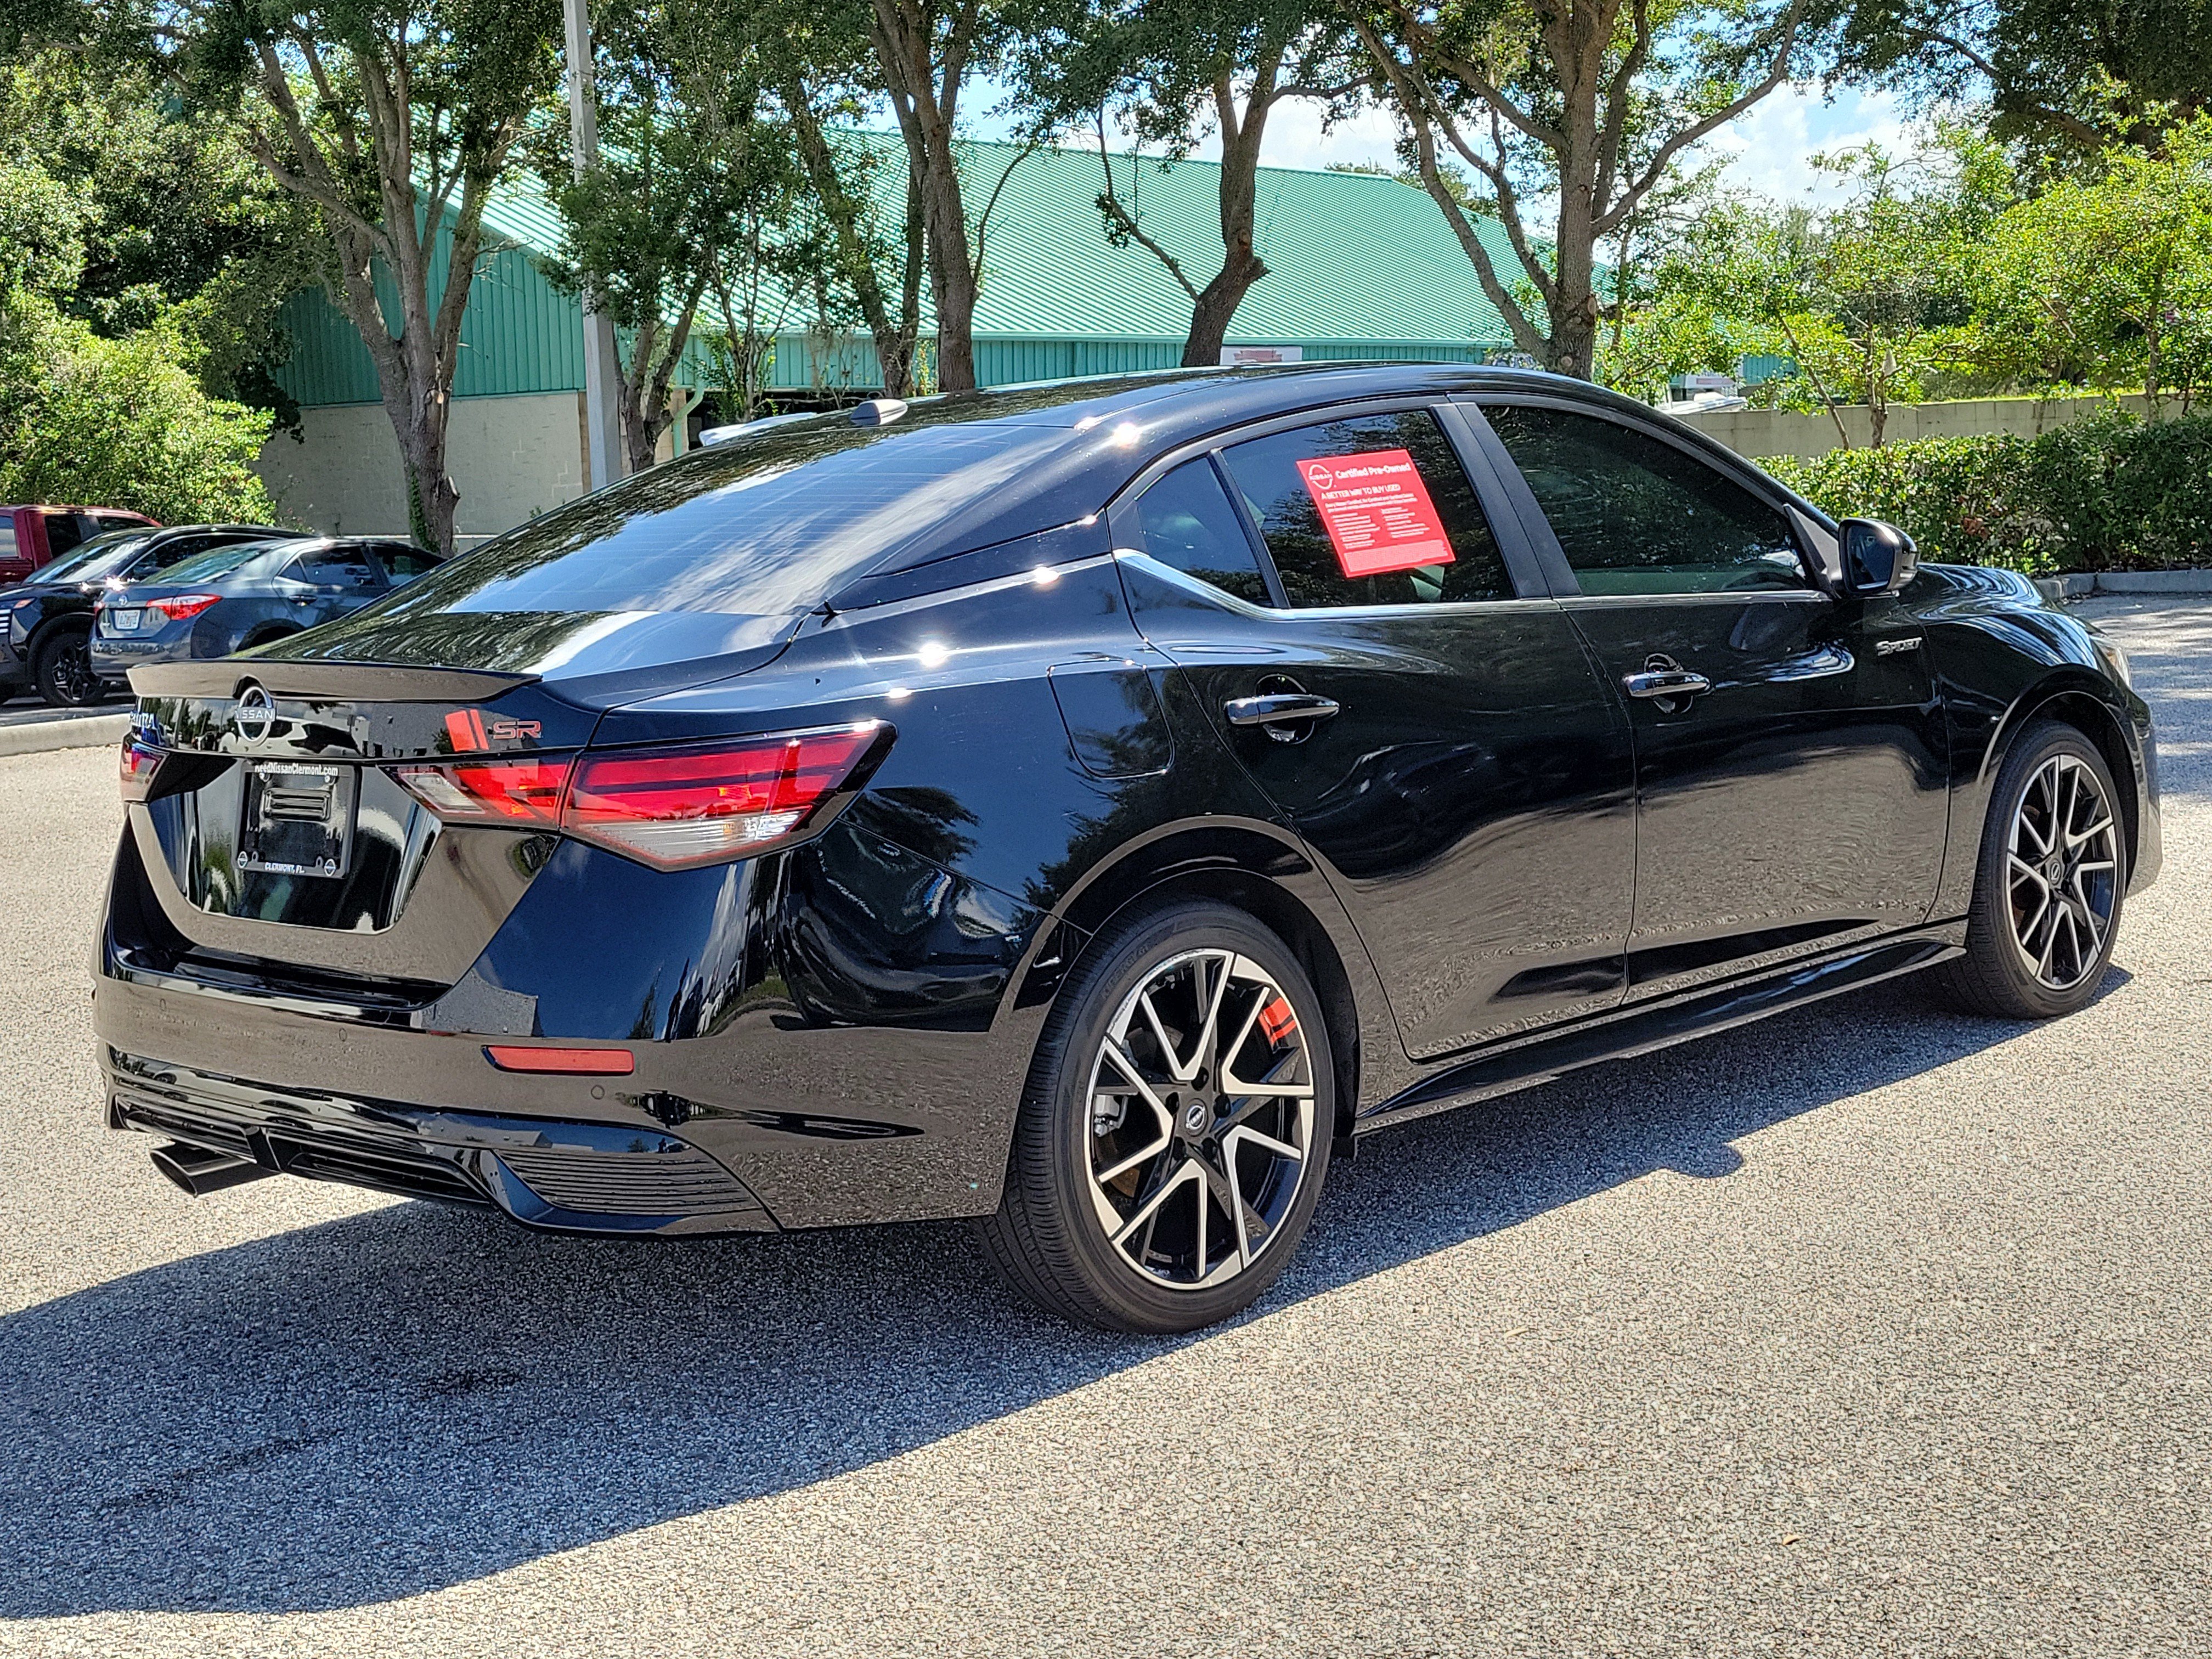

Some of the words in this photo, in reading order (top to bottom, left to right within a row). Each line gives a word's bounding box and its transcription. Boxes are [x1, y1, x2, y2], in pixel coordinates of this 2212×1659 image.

[1335, 467, 1369, 479] Certified
[1369, 462, 1411, 475] Pre-Owned
[1327, 489, 1349, 498] BETTER
[1350, 488, 1364, 496] WAY
[1384, 483, 1401, 492] USED
[234, 709, 273, 719] NISSAN
[493, 721, 541, 739] SR
